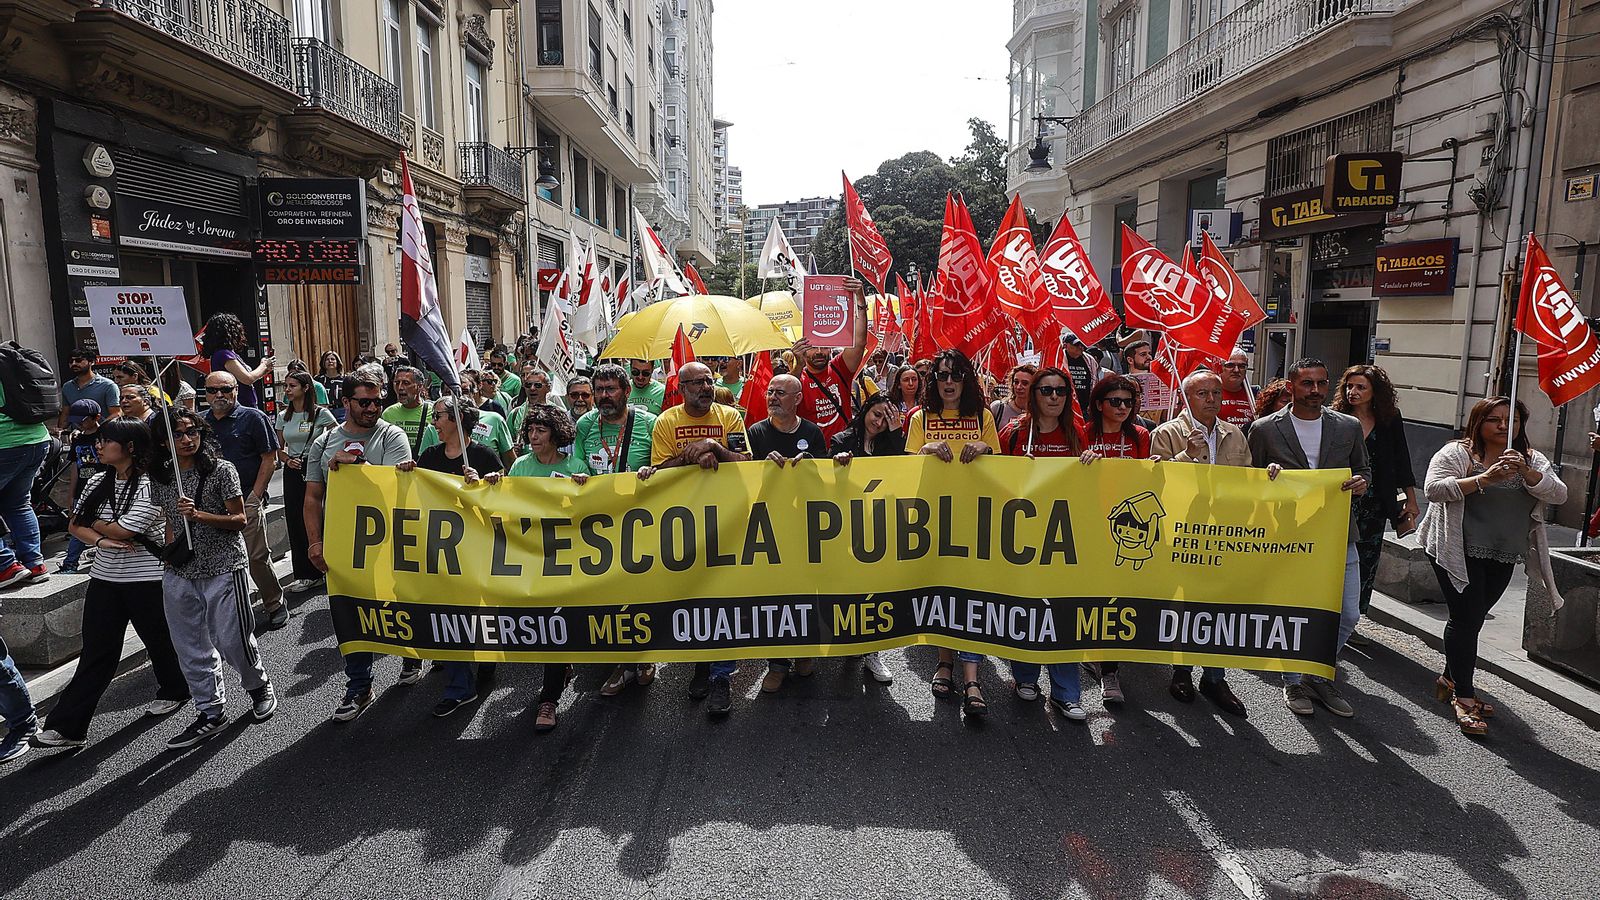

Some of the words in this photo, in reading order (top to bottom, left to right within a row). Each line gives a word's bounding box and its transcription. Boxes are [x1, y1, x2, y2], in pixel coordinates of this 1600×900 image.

[1337, 195, 1394, 207] TABACOS
[320, 210, 353, 218] REFINERÍA
[1292, 199, 1325, 220] TAB
[138, 210, 184, 232] Júdez
[197, 220, 237, 239] Serena
[305, 217, 344, 225] INVERSIÓN
[1389, 255, 1445, 268] TABACOS
[264, 268, 354, 281] EXCHANGE
[1046, 241, 1101, 297] UGT
[1137, 254, 1202, 305] UGT
[117, 292, 154, 305] STOP!
[110, 306, 163, 316] RETALLADES
[813, 304, 840, 312] Salvem
[109, 317, 115, 326] A
[116, 315, 167, 326] L'EDUCACIÓ
[813, 311, 841, 319] l'escola
[813, 319, 840, 327] pública
[122, 325, 158, 336] PÚBLICA
[815, 404, 836, 412] l'esc
[816, 409, 837, 419] públi
[926, 431, 980, 440] educació
[352, 504, 466, 576] PER
[490, 500, 782, 577] L'ESCOLA
[806, 479, 1079, 566] PÚBLICA
[1174, 521, 1266, 539] PLATAFORMA
[1172, 537, 1201, 551] PER
[1205, 539, 1315, 554] L'ENSENYAMENT
[1171, 550, 1223, 567] PÚBLIC
[356, 602, 414, 642] MÉS
[430, 606, 568, 645] INVERSIÓ
[588, 605, 652, 645] MÉS
[671, 603, 813, 642] QUALITAT
[832, 593, 895, 636] MÉS
[911, 595, 1058, 643] VALENCIÀ
[1075, 597, 1138, 642] MÉS
[1157, 608, 1309, 651] DIGNITAT
